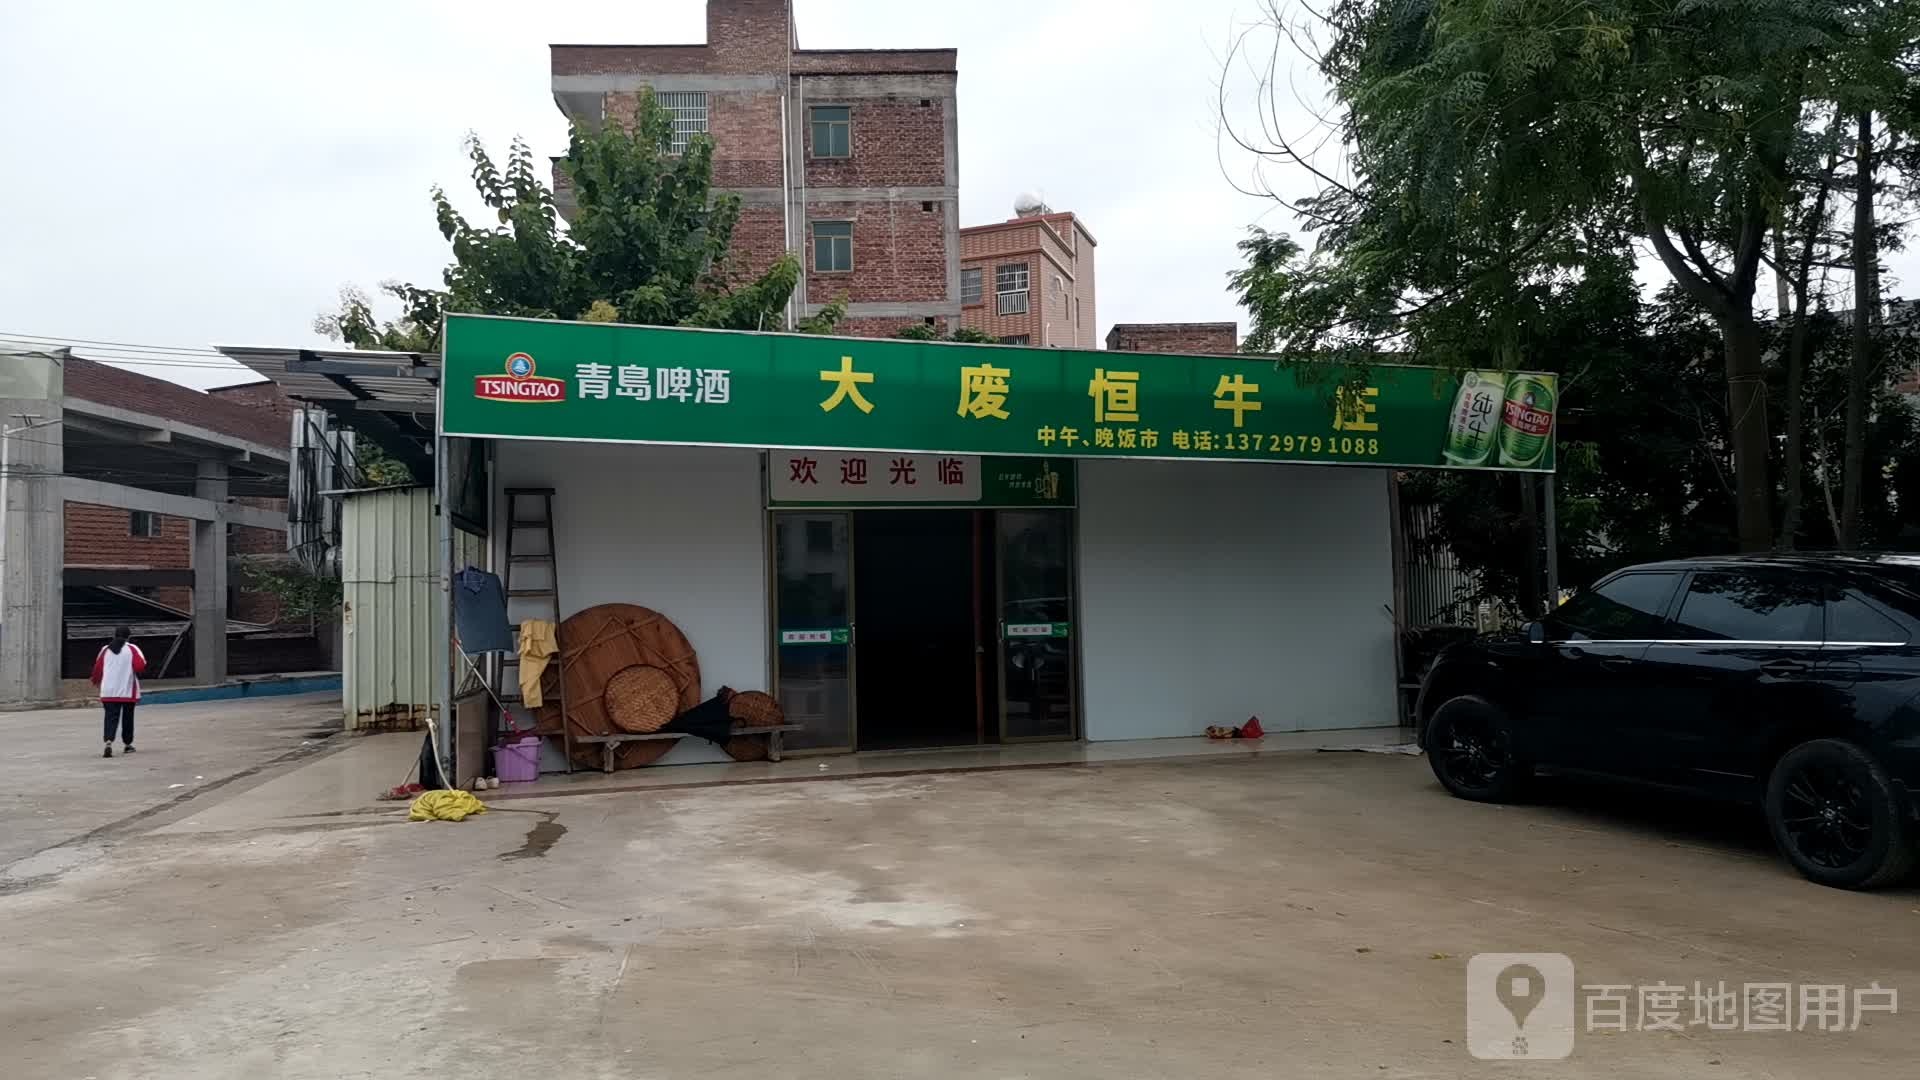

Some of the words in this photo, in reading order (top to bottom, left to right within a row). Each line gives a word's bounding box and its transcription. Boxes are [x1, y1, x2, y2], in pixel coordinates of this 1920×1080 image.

[481, 380, 560, 397] TSINGTAO
[575, 362, 731, 405] 青岛啤酒
[1505, 401, 1550, 426] TSINGTAO
[1037, 425, 1159, 449] 中午、晚饭市
[789, 456, 965, 485] 欢迎光临
